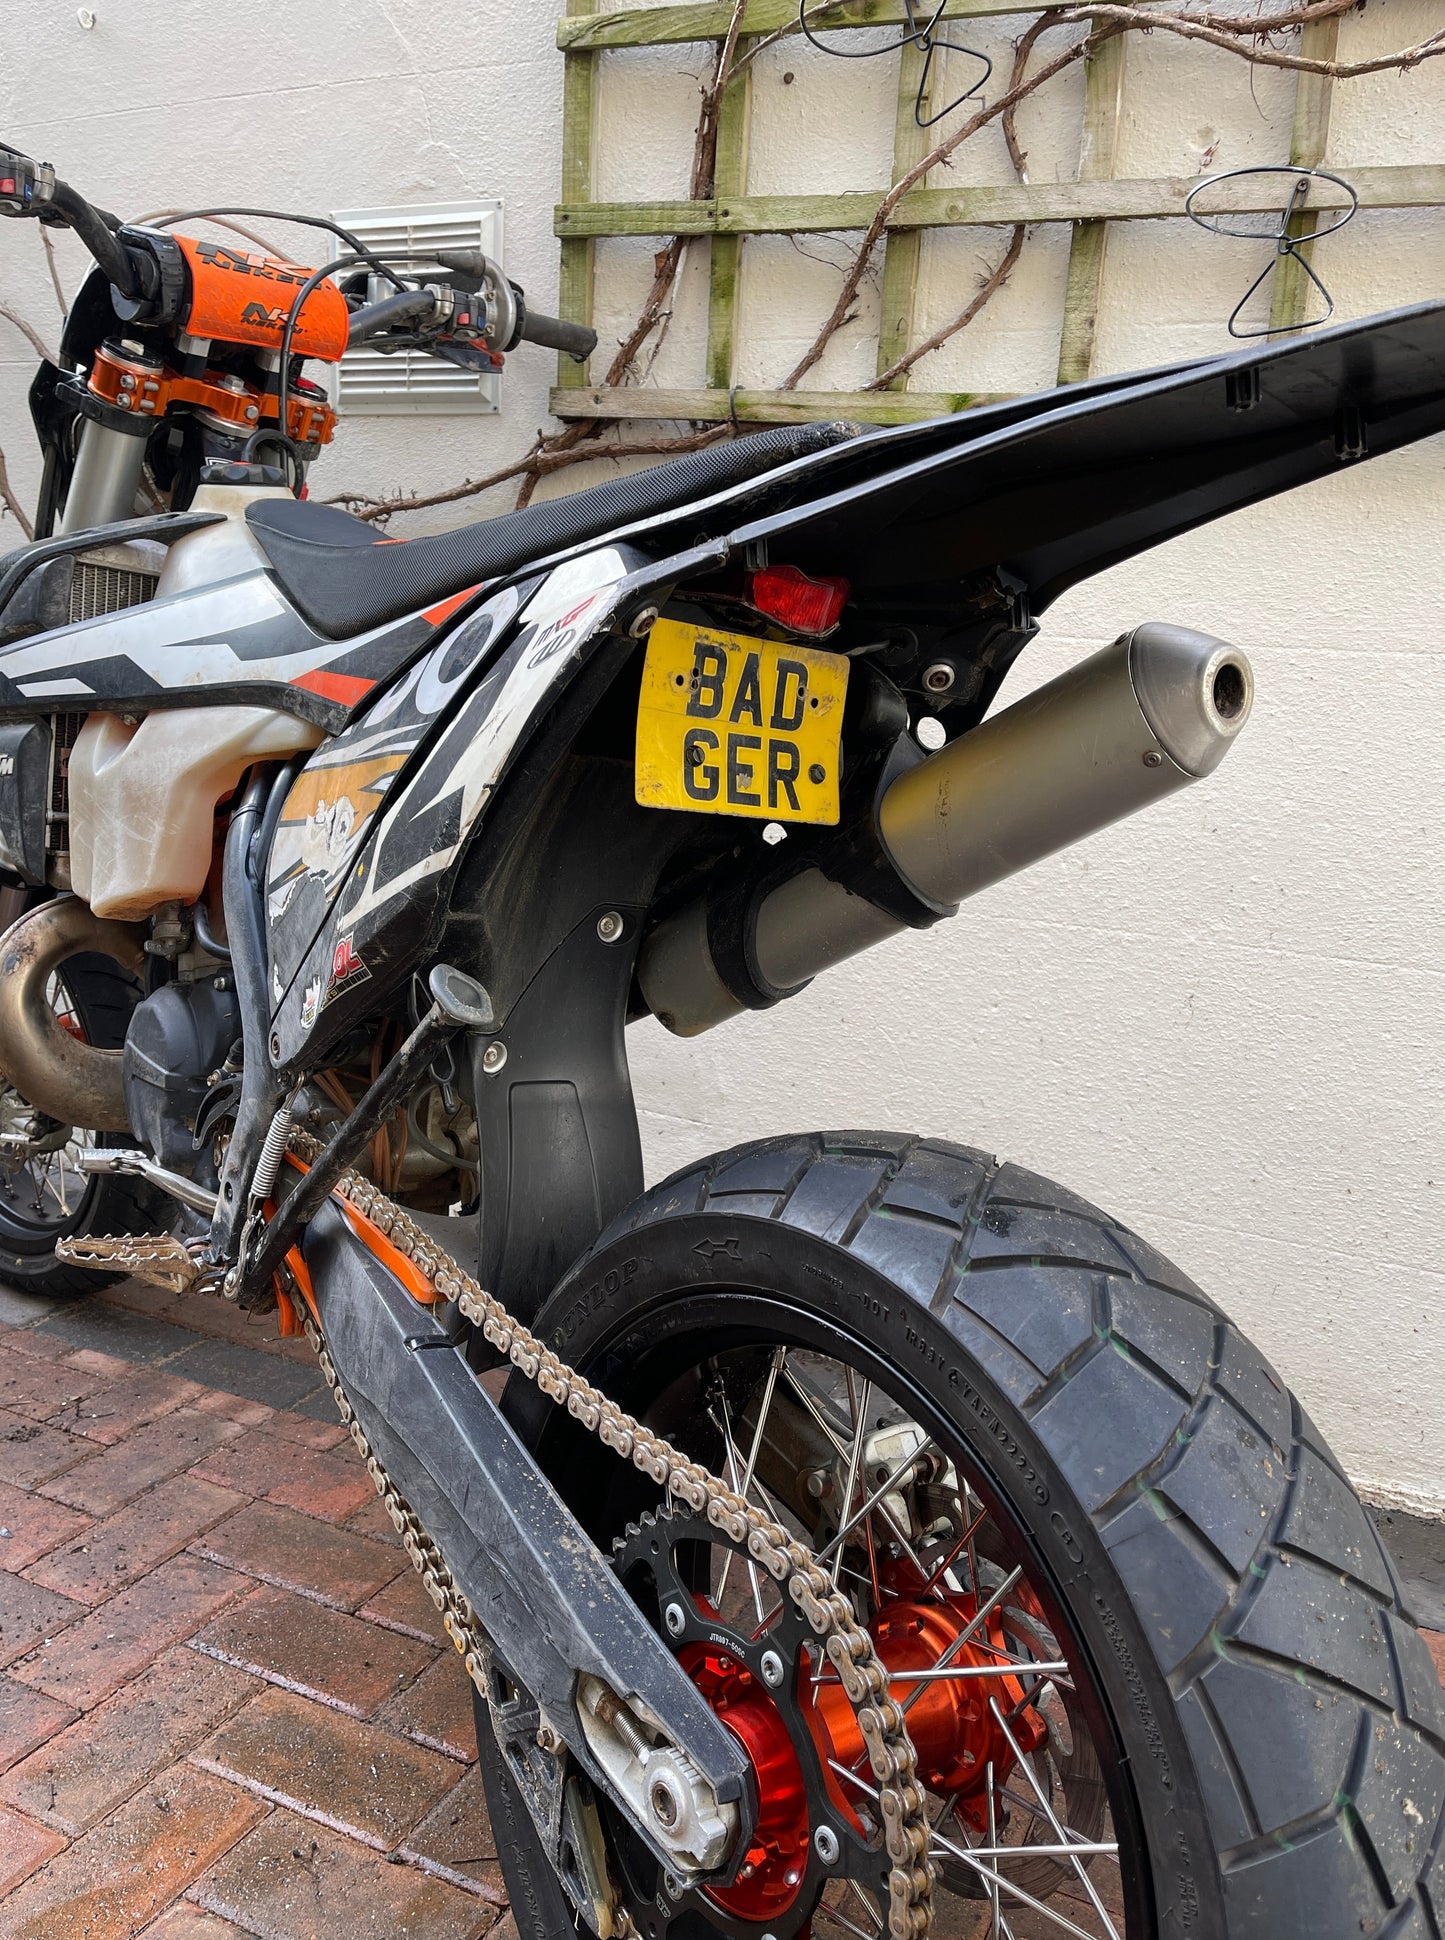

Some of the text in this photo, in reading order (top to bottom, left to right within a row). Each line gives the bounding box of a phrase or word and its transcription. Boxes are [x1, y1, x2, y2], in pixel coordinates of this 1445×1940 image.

[686, 641, 808, 731] BAD
[684, 728, 801, 811] GER
[550, 1256, 639, 1350] DUNLOP
[863, 1292, 890, 1323] DOT
